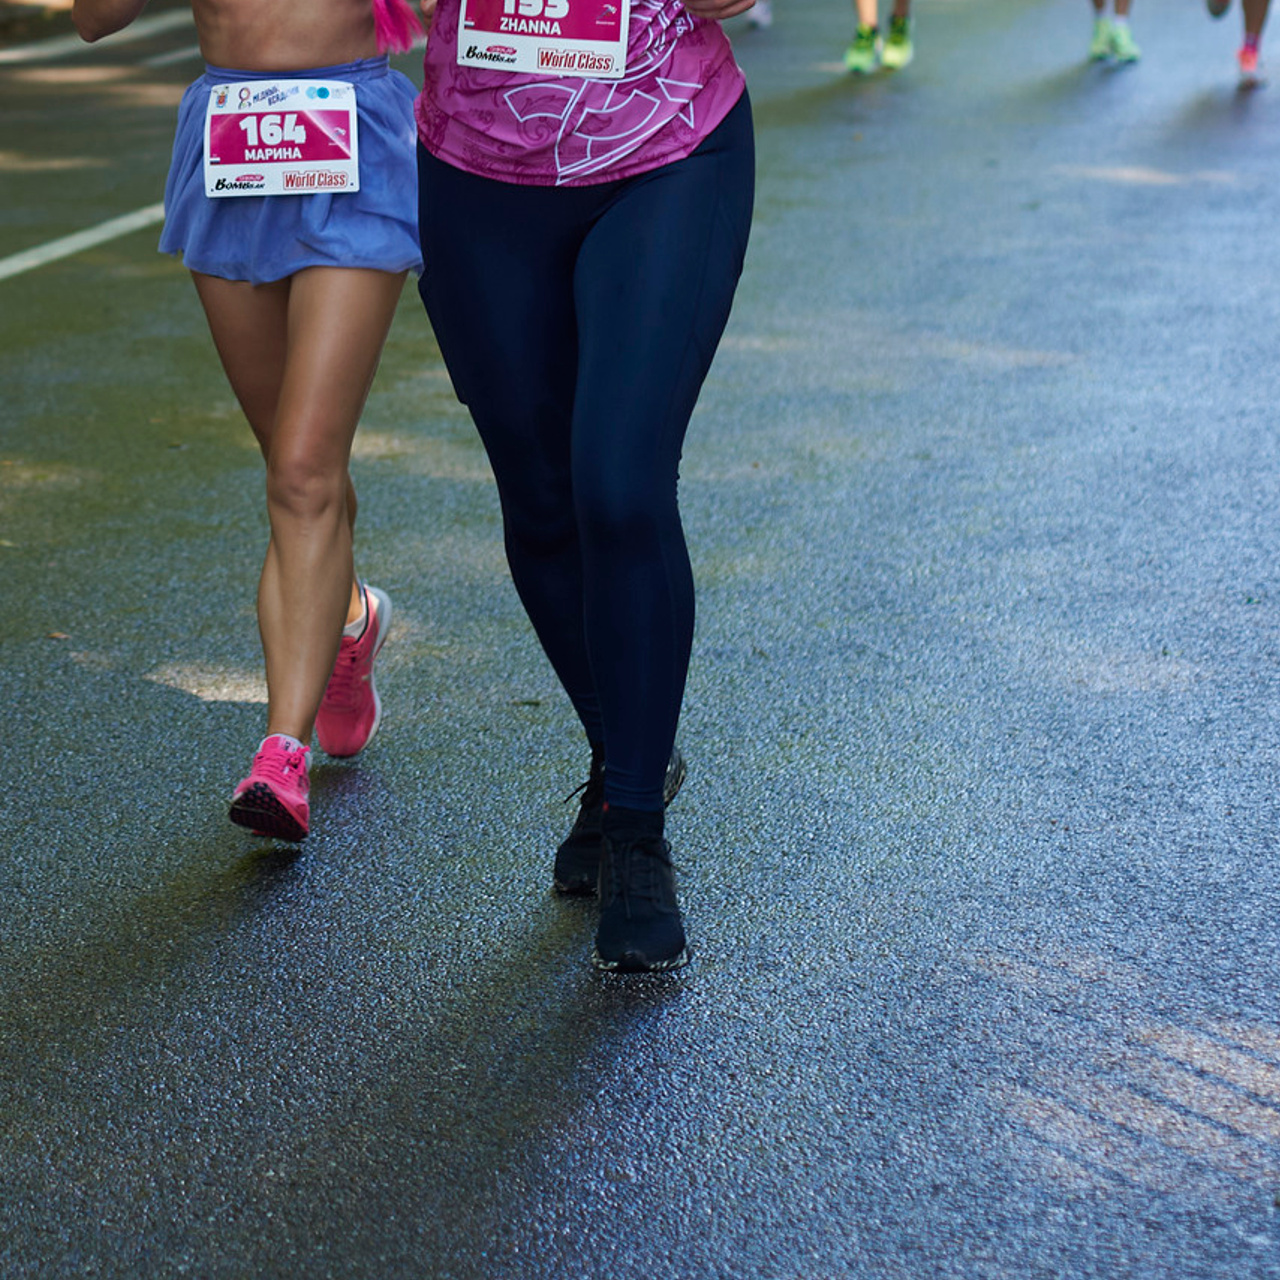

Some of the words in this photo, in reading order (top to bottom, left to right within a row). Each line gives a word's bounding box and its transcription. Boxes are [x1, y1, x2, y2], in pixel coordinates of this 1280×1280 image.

[499, 17, 562, 36] ZHANNA
[540, 50, 575, 69] World
[577, 54, 612, 71] Class
[239, 114, 307, 146] 164
[244, 147, 302, 161] МАРИНА
[285, 173, 316, 188] World
[318, 171, 346, 187] Class
